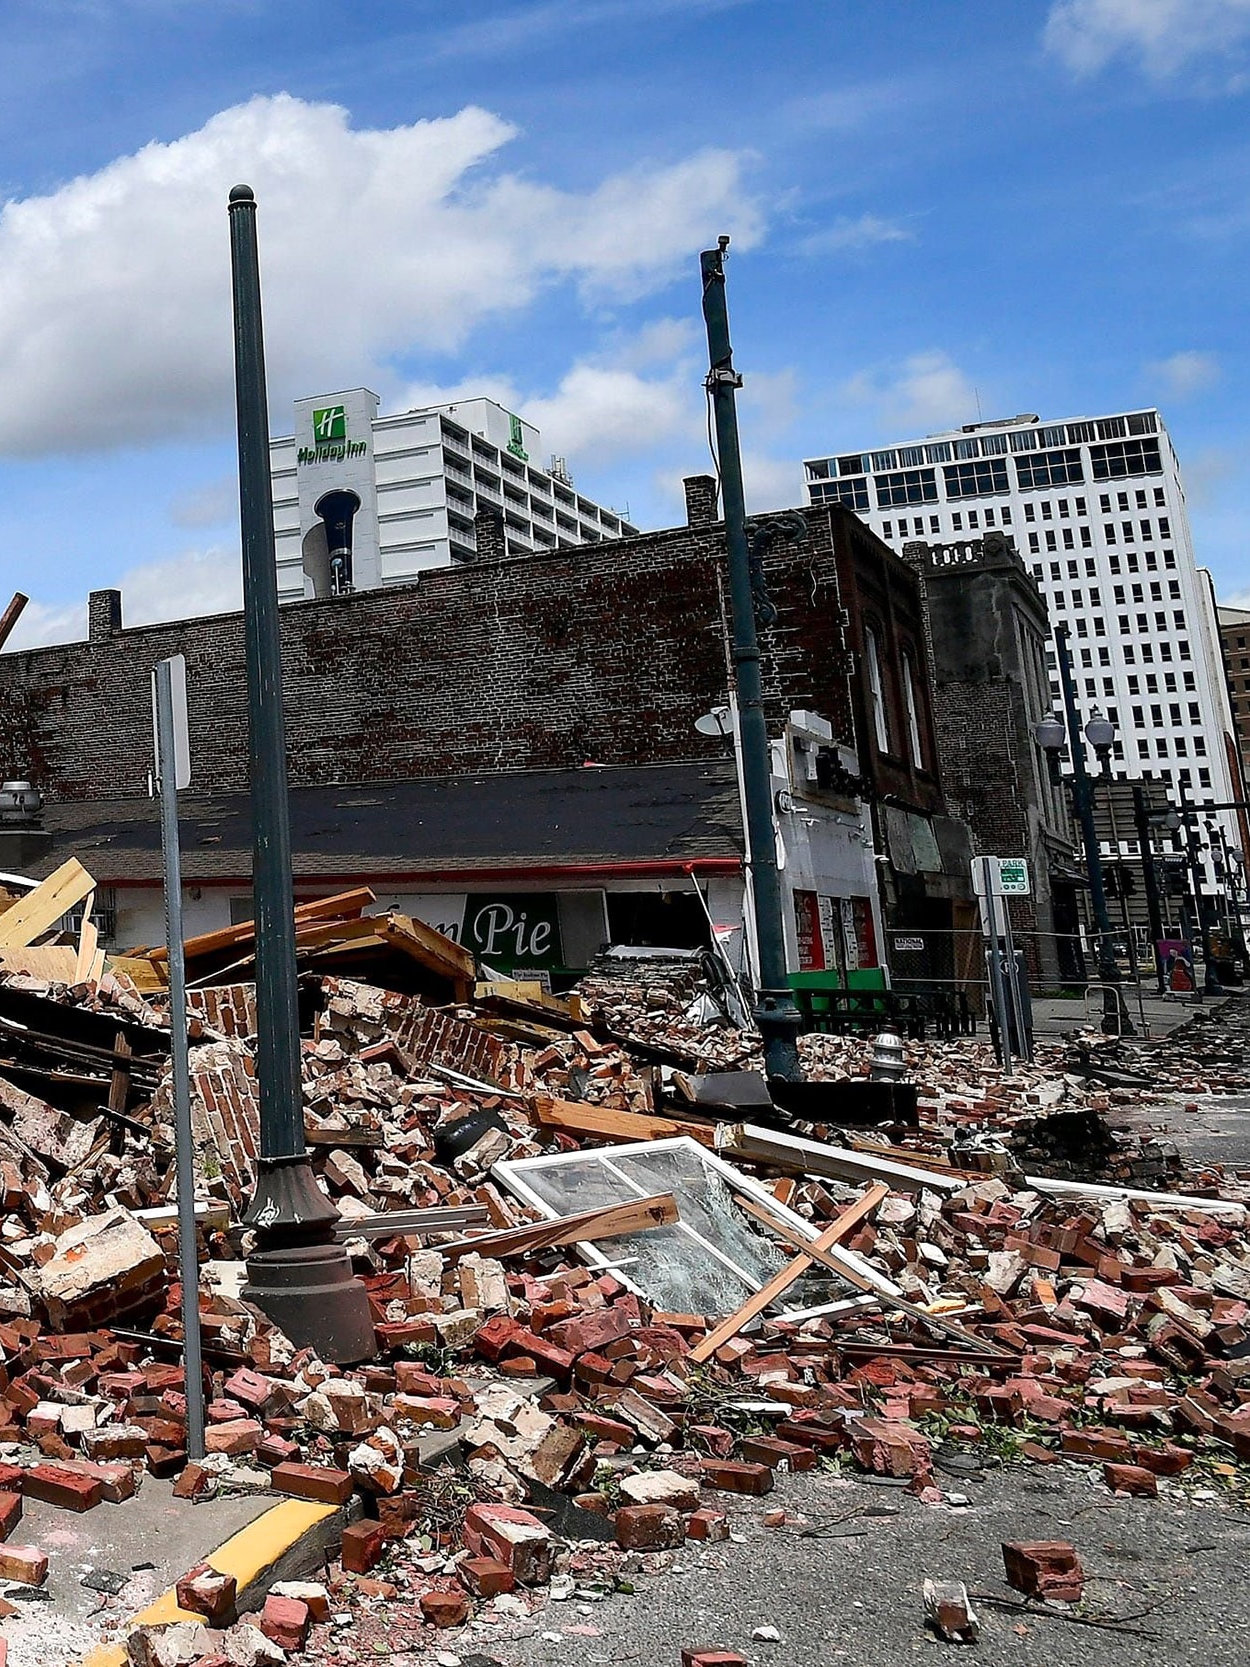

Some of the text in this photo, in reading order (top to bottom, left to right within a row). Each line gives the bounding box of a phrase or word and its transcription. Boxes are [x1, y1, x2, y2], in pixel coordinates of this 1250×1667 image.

[297, 440, 367, 465] Holiday Inn
[473, 903, 551, 956] Pie
